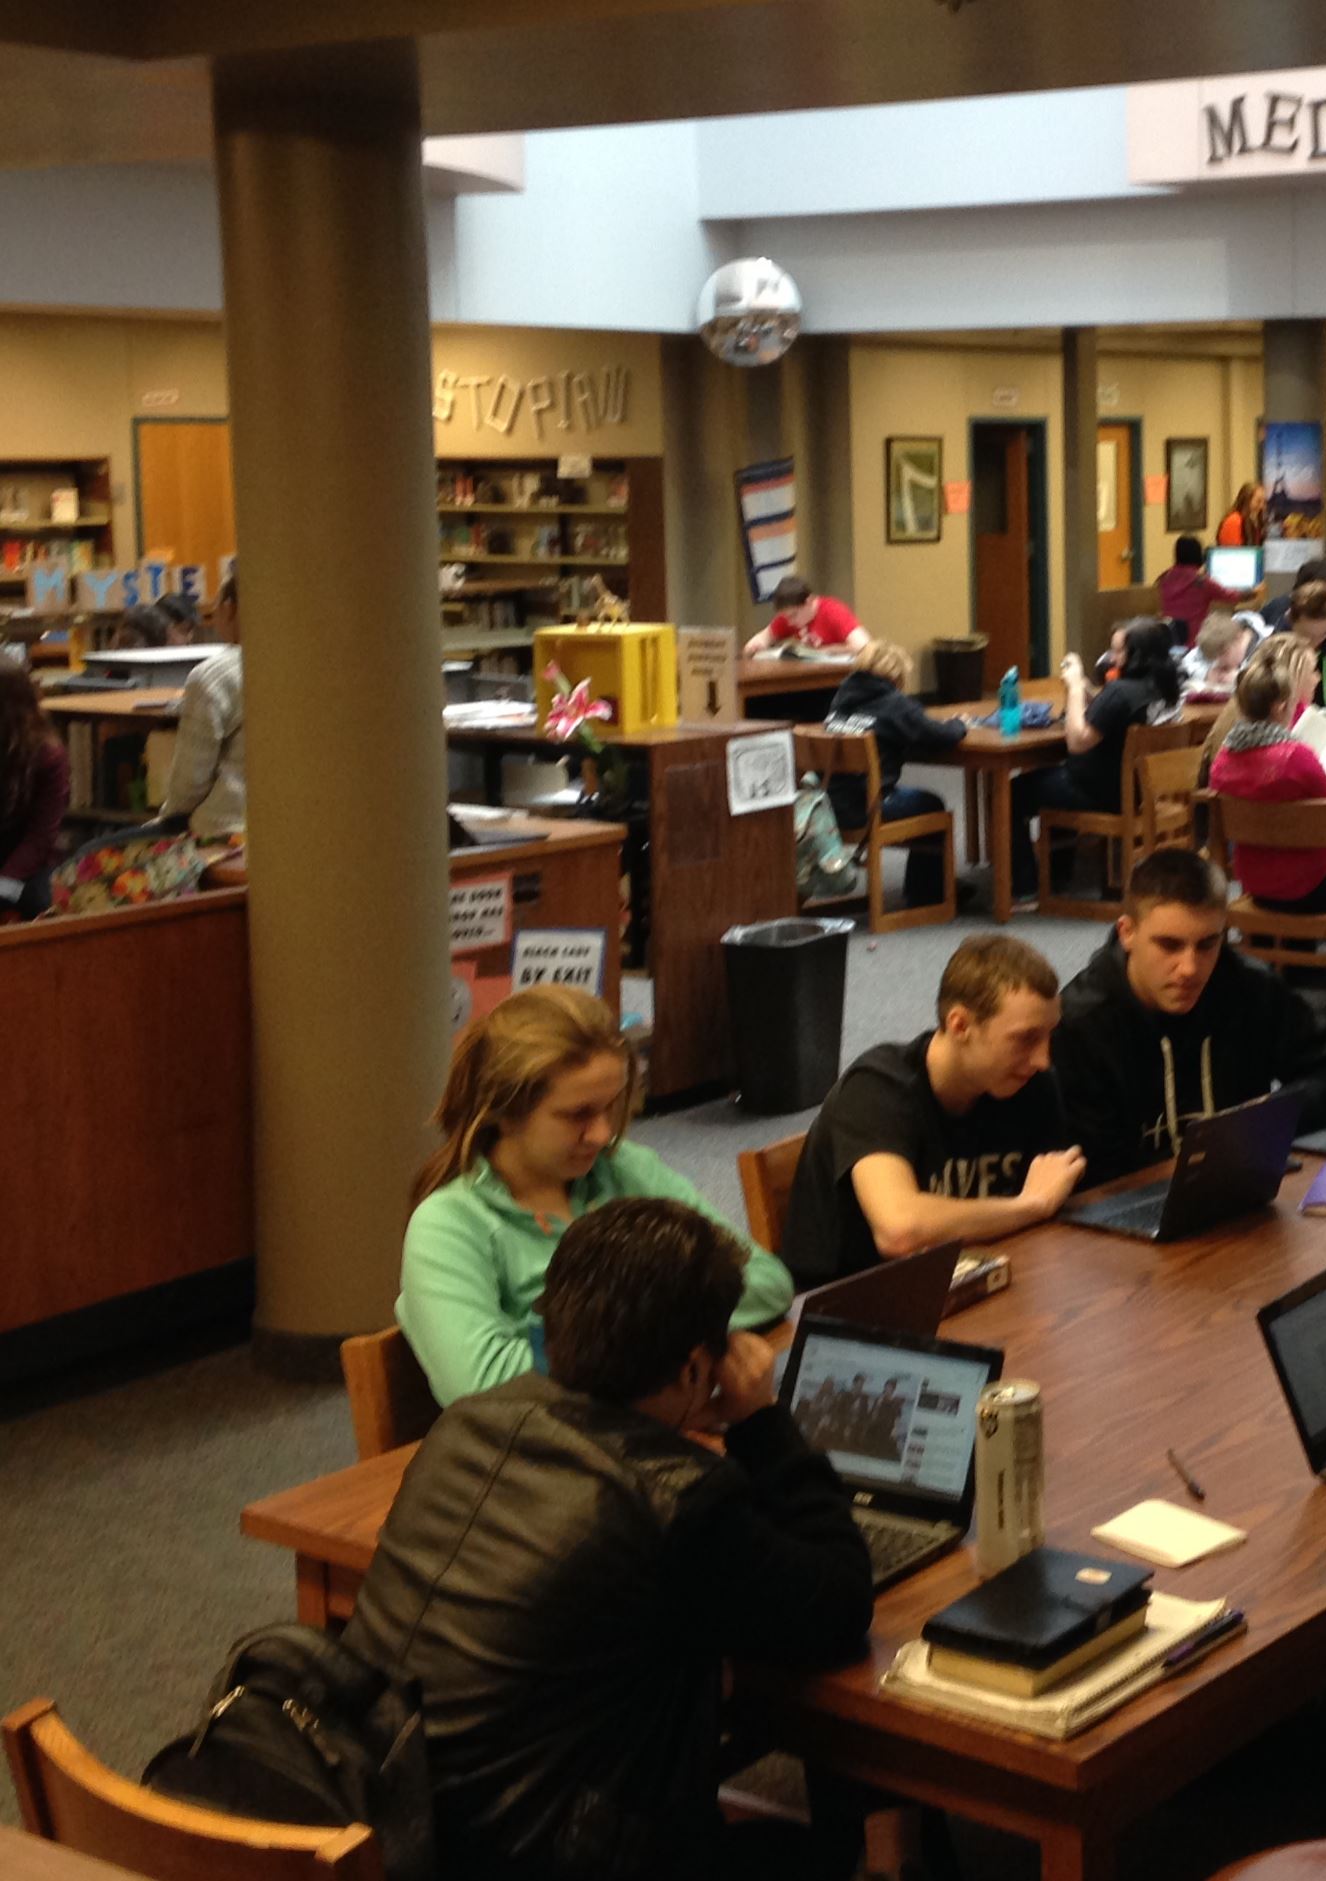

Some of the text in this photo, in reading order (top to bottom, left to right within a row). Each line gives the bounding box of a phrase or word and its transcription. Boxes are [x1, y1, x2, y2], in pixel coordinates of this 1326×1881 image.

[34, 560, 237, 609] MYSTE
[520, 966, 593, 985] BY EXIT
